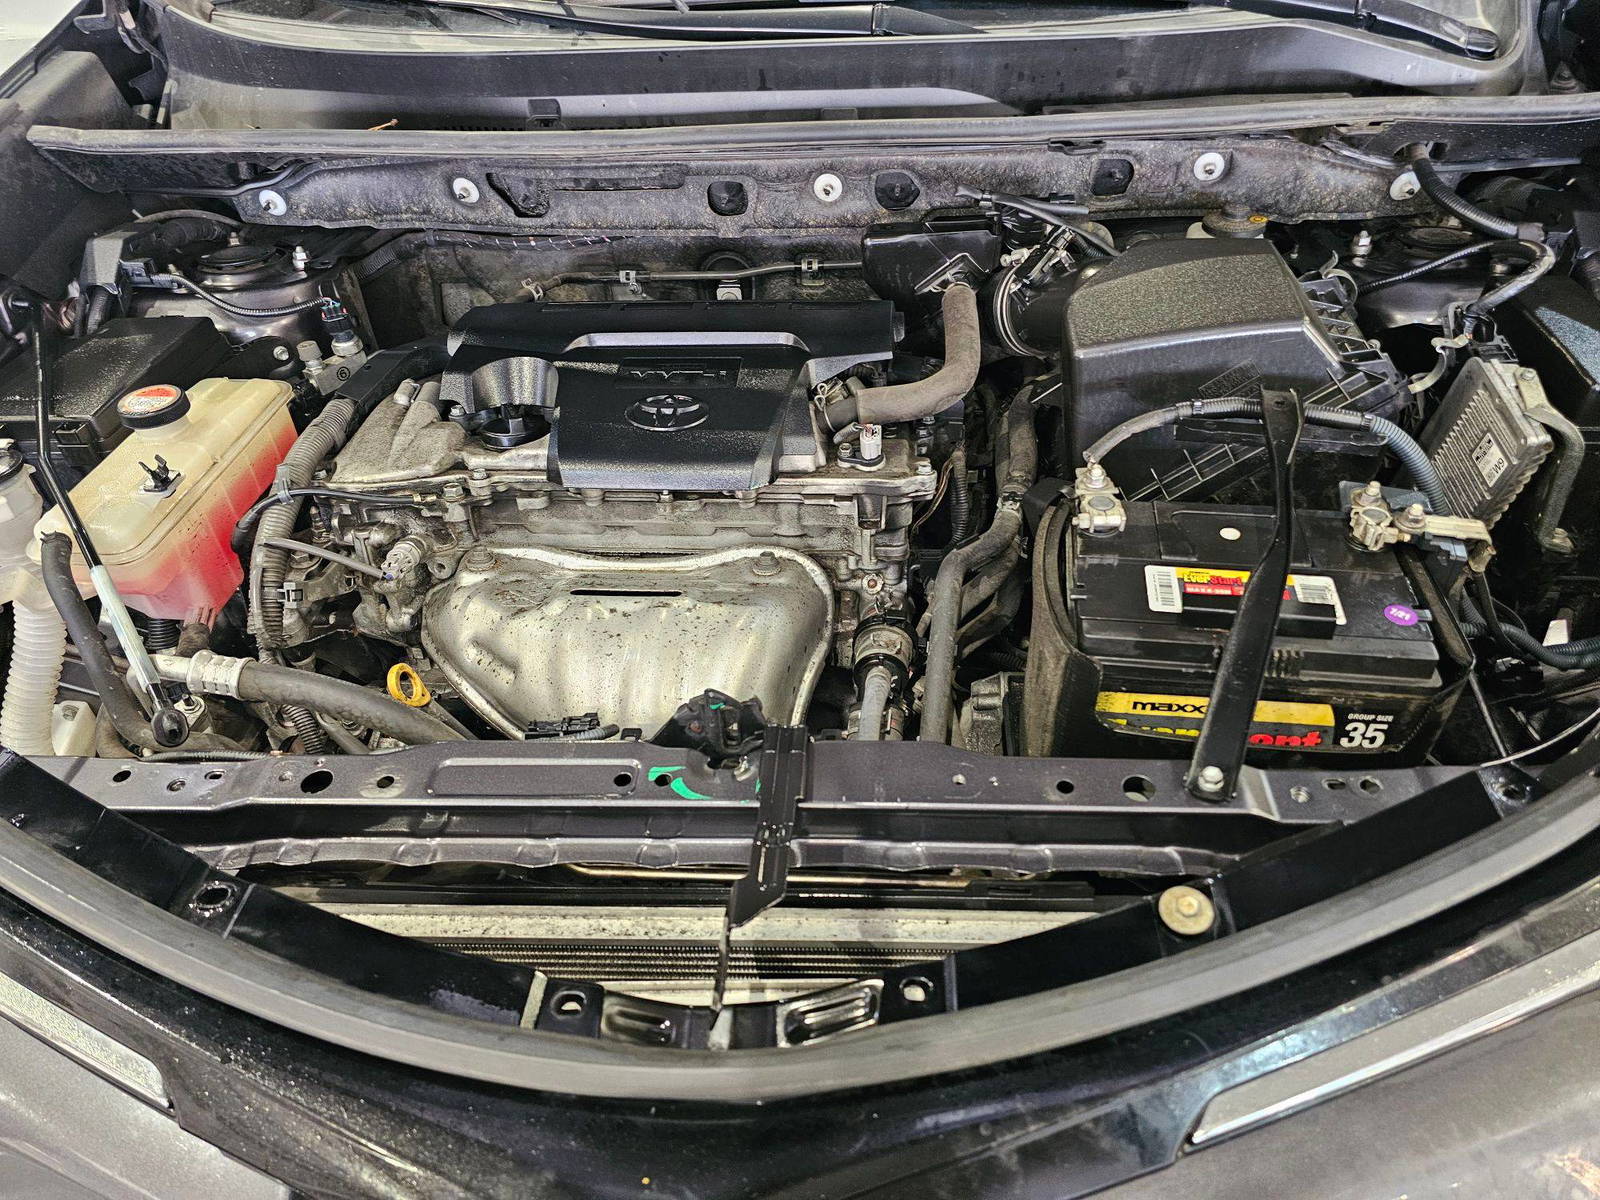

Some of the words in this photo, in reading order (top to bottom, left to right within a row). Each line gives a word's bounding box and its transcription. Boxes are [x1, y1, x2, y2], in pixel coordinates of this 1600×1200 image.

[1184, 572, 1242, 586] EverStart
[1347, 713, 1376, 721] GROUP
[1340, 721, 1389, 749] 35
